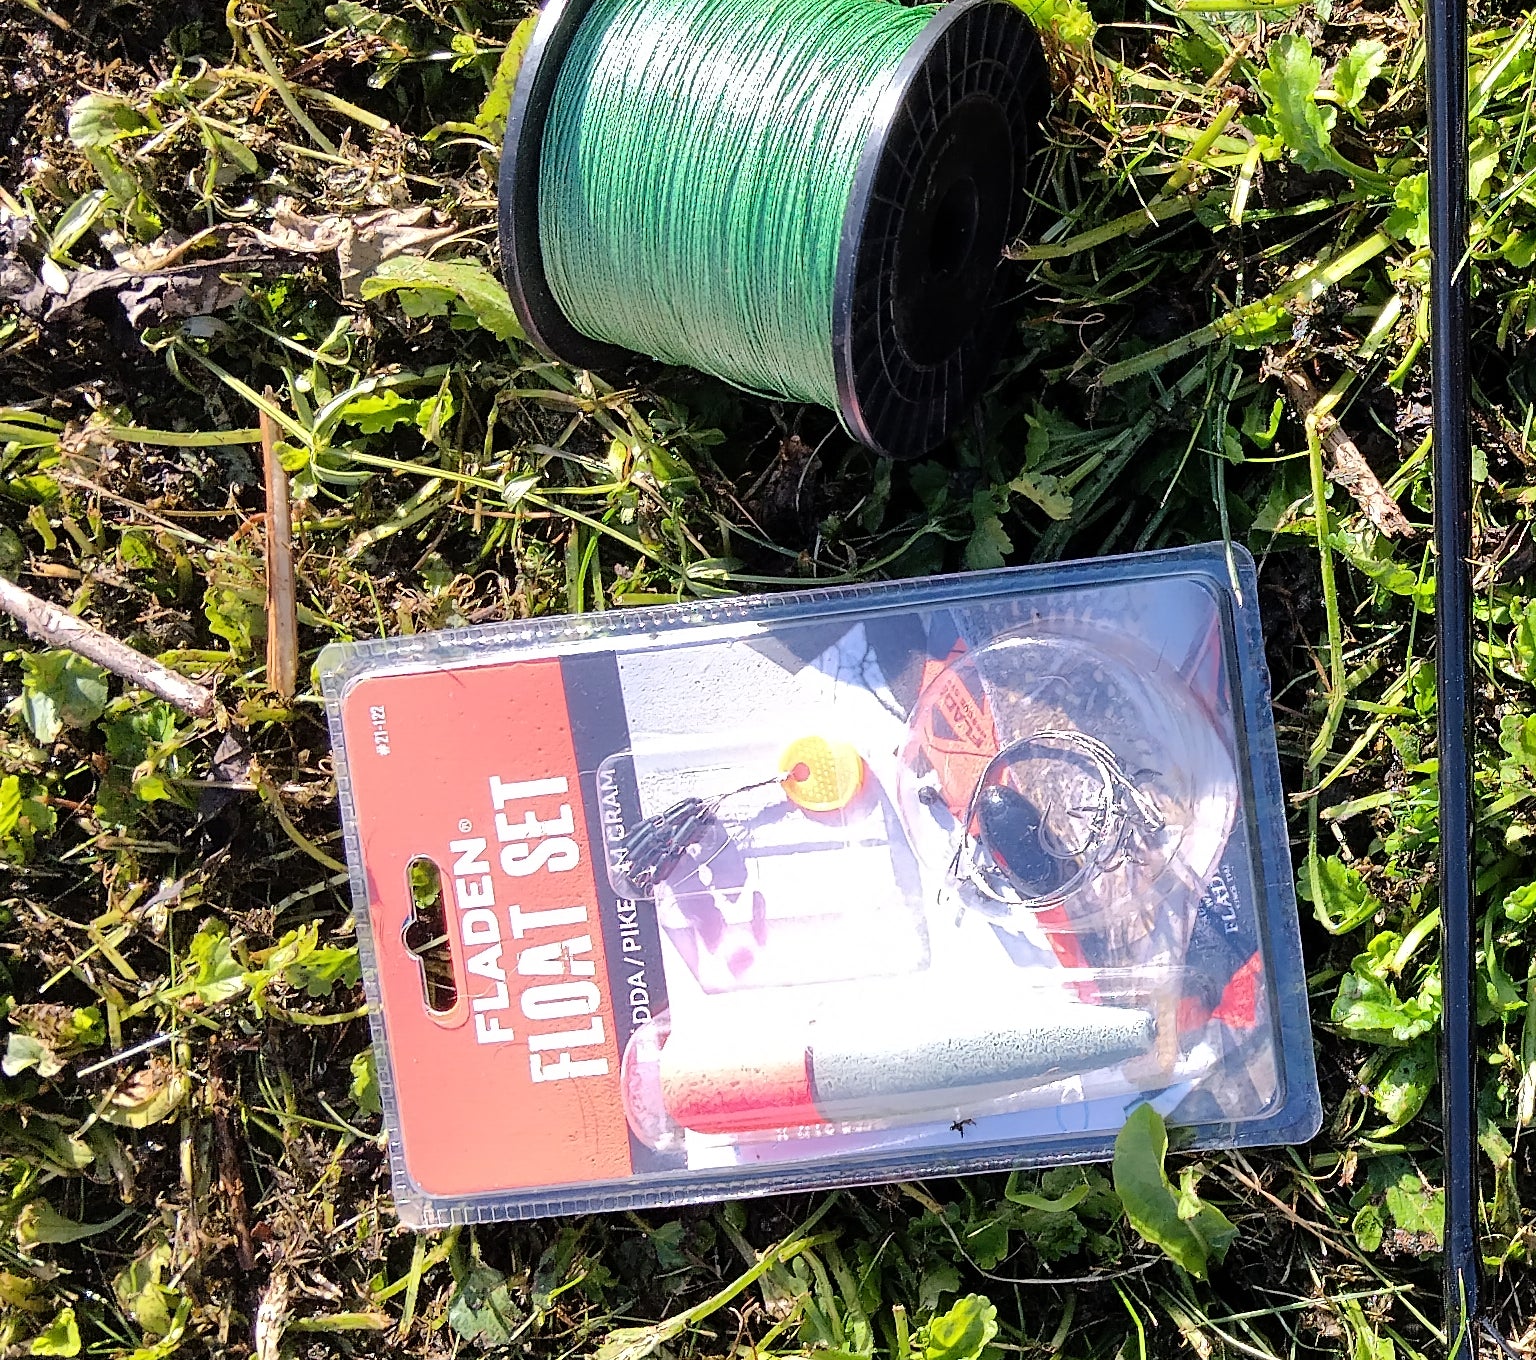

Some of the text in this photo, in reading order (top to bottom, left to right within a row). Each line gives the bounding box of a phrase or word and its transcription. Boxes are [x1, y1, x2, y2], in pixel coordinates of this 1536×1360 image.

[370, 705, 392, 756] #21-122
[598, 769, 627, 842] GRAM
[488, 775, 609, 1082] FLOAT SET
[616, 898, 642, 952] PIKE
